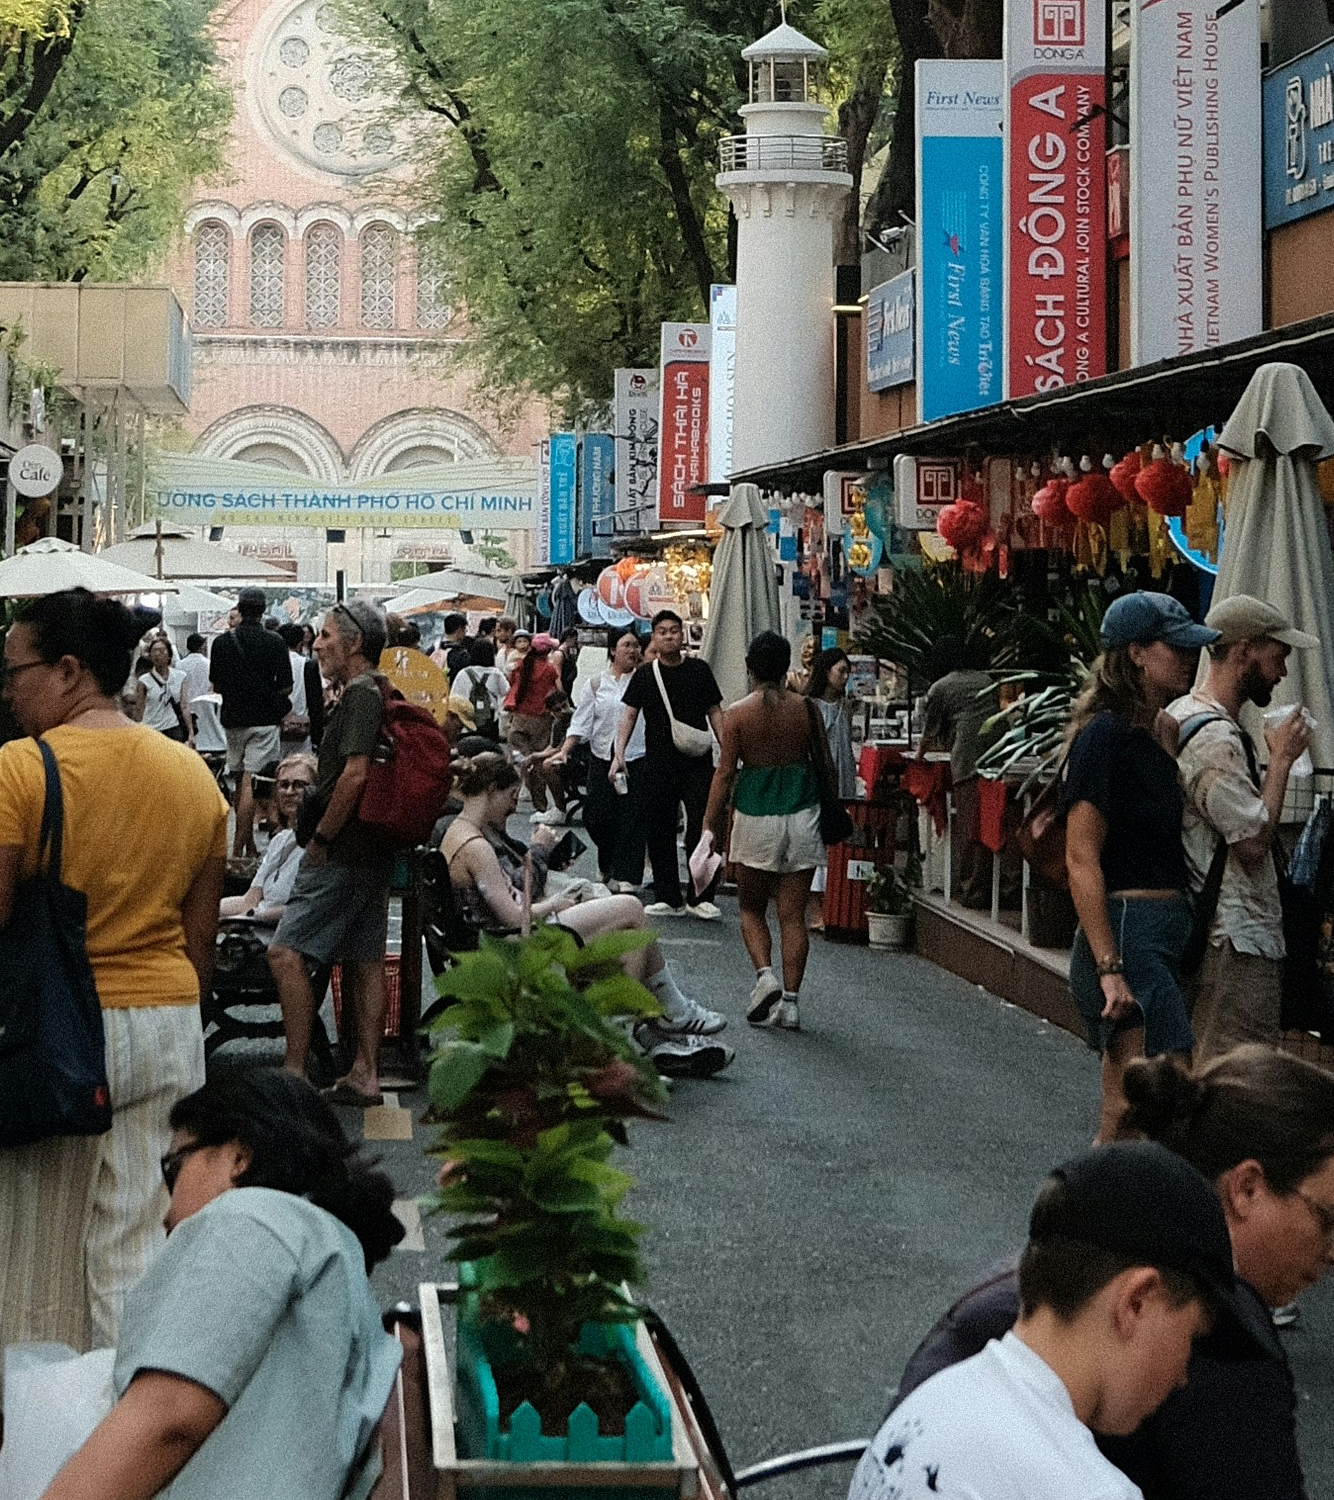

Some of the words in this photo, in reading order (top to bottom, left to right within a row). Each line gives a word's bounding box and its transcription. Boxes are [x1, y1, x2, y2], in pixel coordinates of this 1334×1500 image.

[1176, 11, 1193, 59] NAM
[926, 90, 959, 106] First
[962, 91, 1001, 106] News
[1028, 85, 1066, 119] A
[1077, 85, 1091, 162] COMANY
[1019, 132, 1066, 280] ĐÔNG
[1077, 166, 1091, 213] STOCK
[1077, 218, 1090, 253] JOIN
[947, 262, 966, 307] First
[1077, 256, 1090, 328] CULTURAL
[947, 313, 966, 366] News
[1025, 295, 1066, 392] SÁCH
[1077, 332, 1090, 342] A
[1077, 348, 1090, 382] ONG
[690, 387, 701, 487] HAIHABOOKS
[222, 488, 275, 508] SÁCH
[281, 488, 352, 509] THÀNH
[357, 491, 400, 510] PHỐ
[441, 491, 474, 511] CHÍ
[481, 496, 533, 511] MINH
